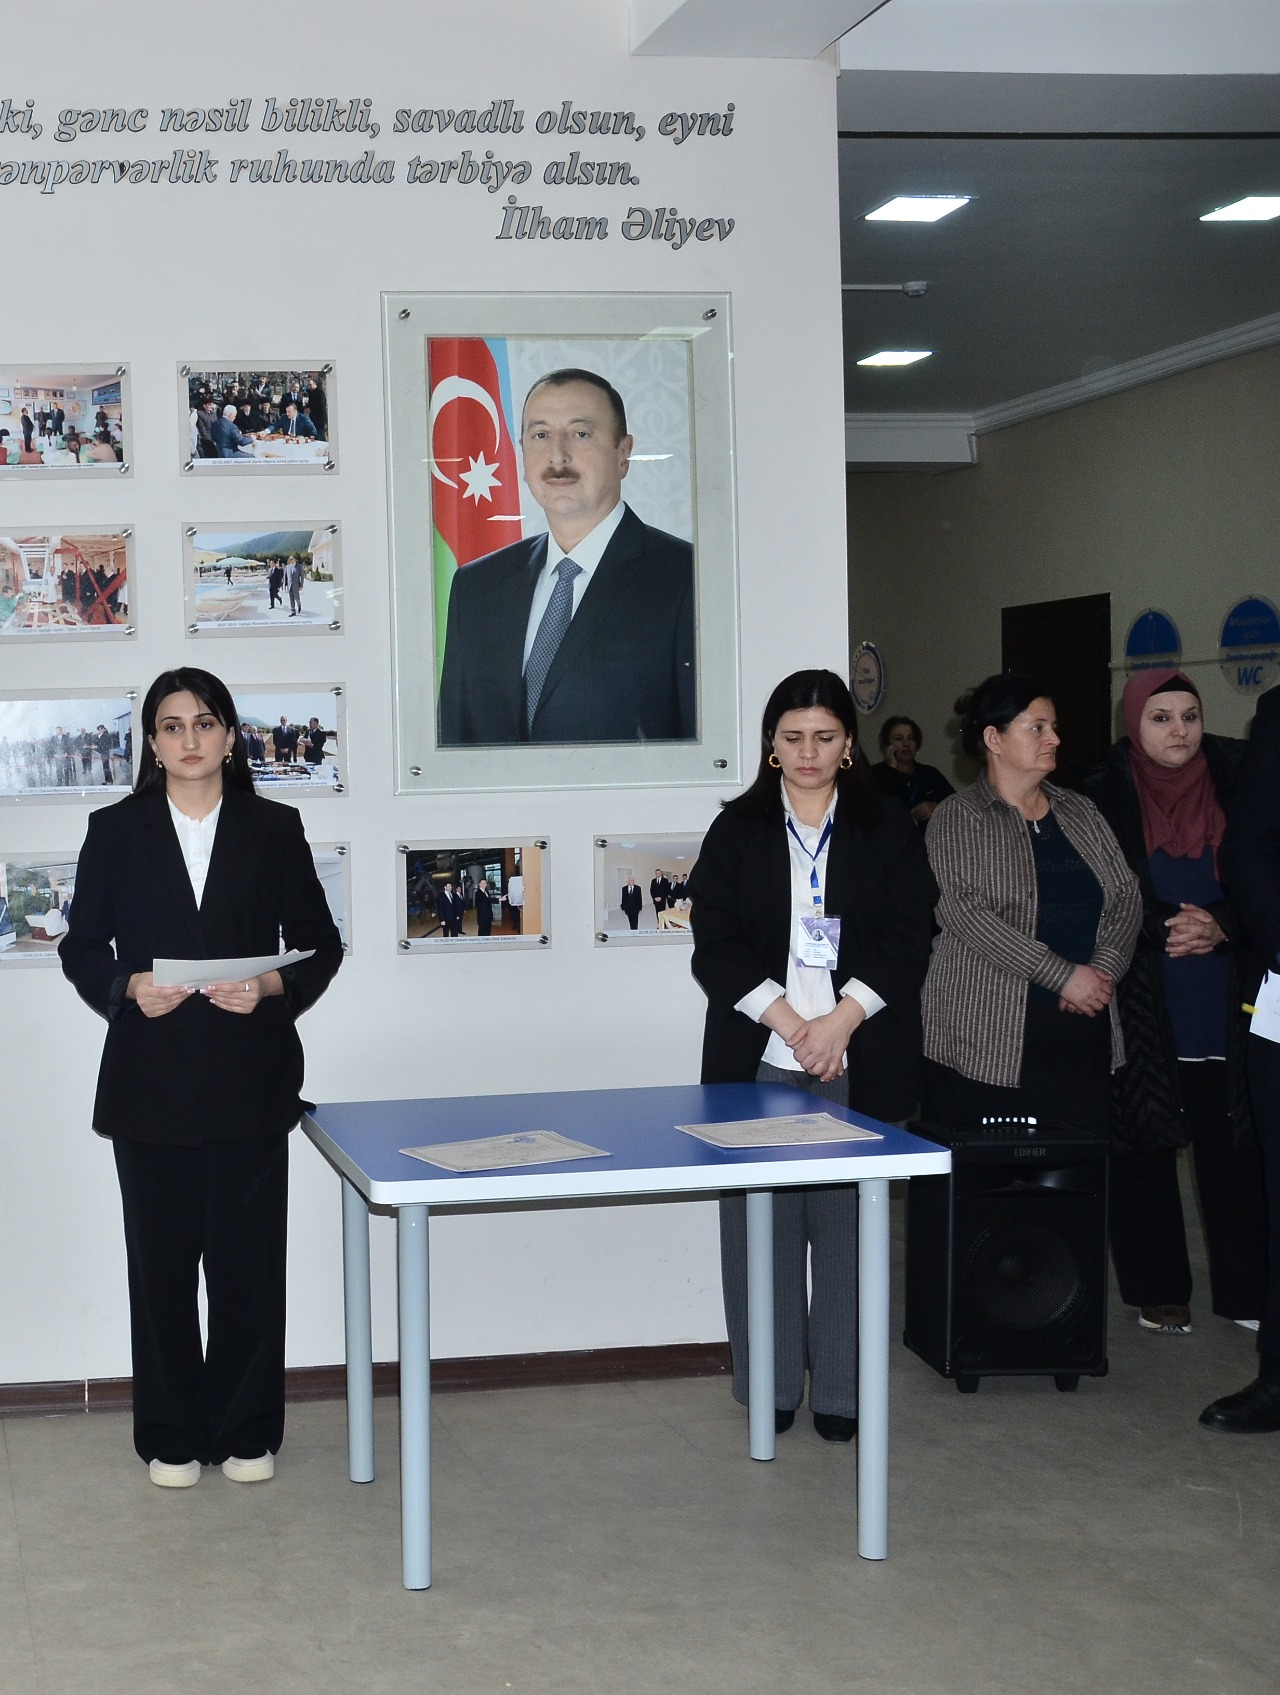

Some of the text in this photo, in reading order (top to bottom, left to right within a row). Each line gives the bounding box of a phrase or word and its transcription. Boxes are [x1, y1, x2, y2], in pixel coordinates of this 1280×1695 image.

[53, 106, 149, 143] gənc
[158, 97, 253, 133] nəsil
[260, 96, 381, 140] bilikli,
[392, 98, 525, 135] savadlı
[535, 100, 647, 143] olsun,
[657, 102, 736, 146] eyni
[229, 148, 396, 185] ruhunda
[406, 149, 533, 195] tərbiyə
[542, 150, 641, 187] alsın.
[494, 194, 736, 251] İlham Əliyev
[1237, 665, 1264, 686] WC
[1014, 1147, 1046, 1157] EDIFIER
